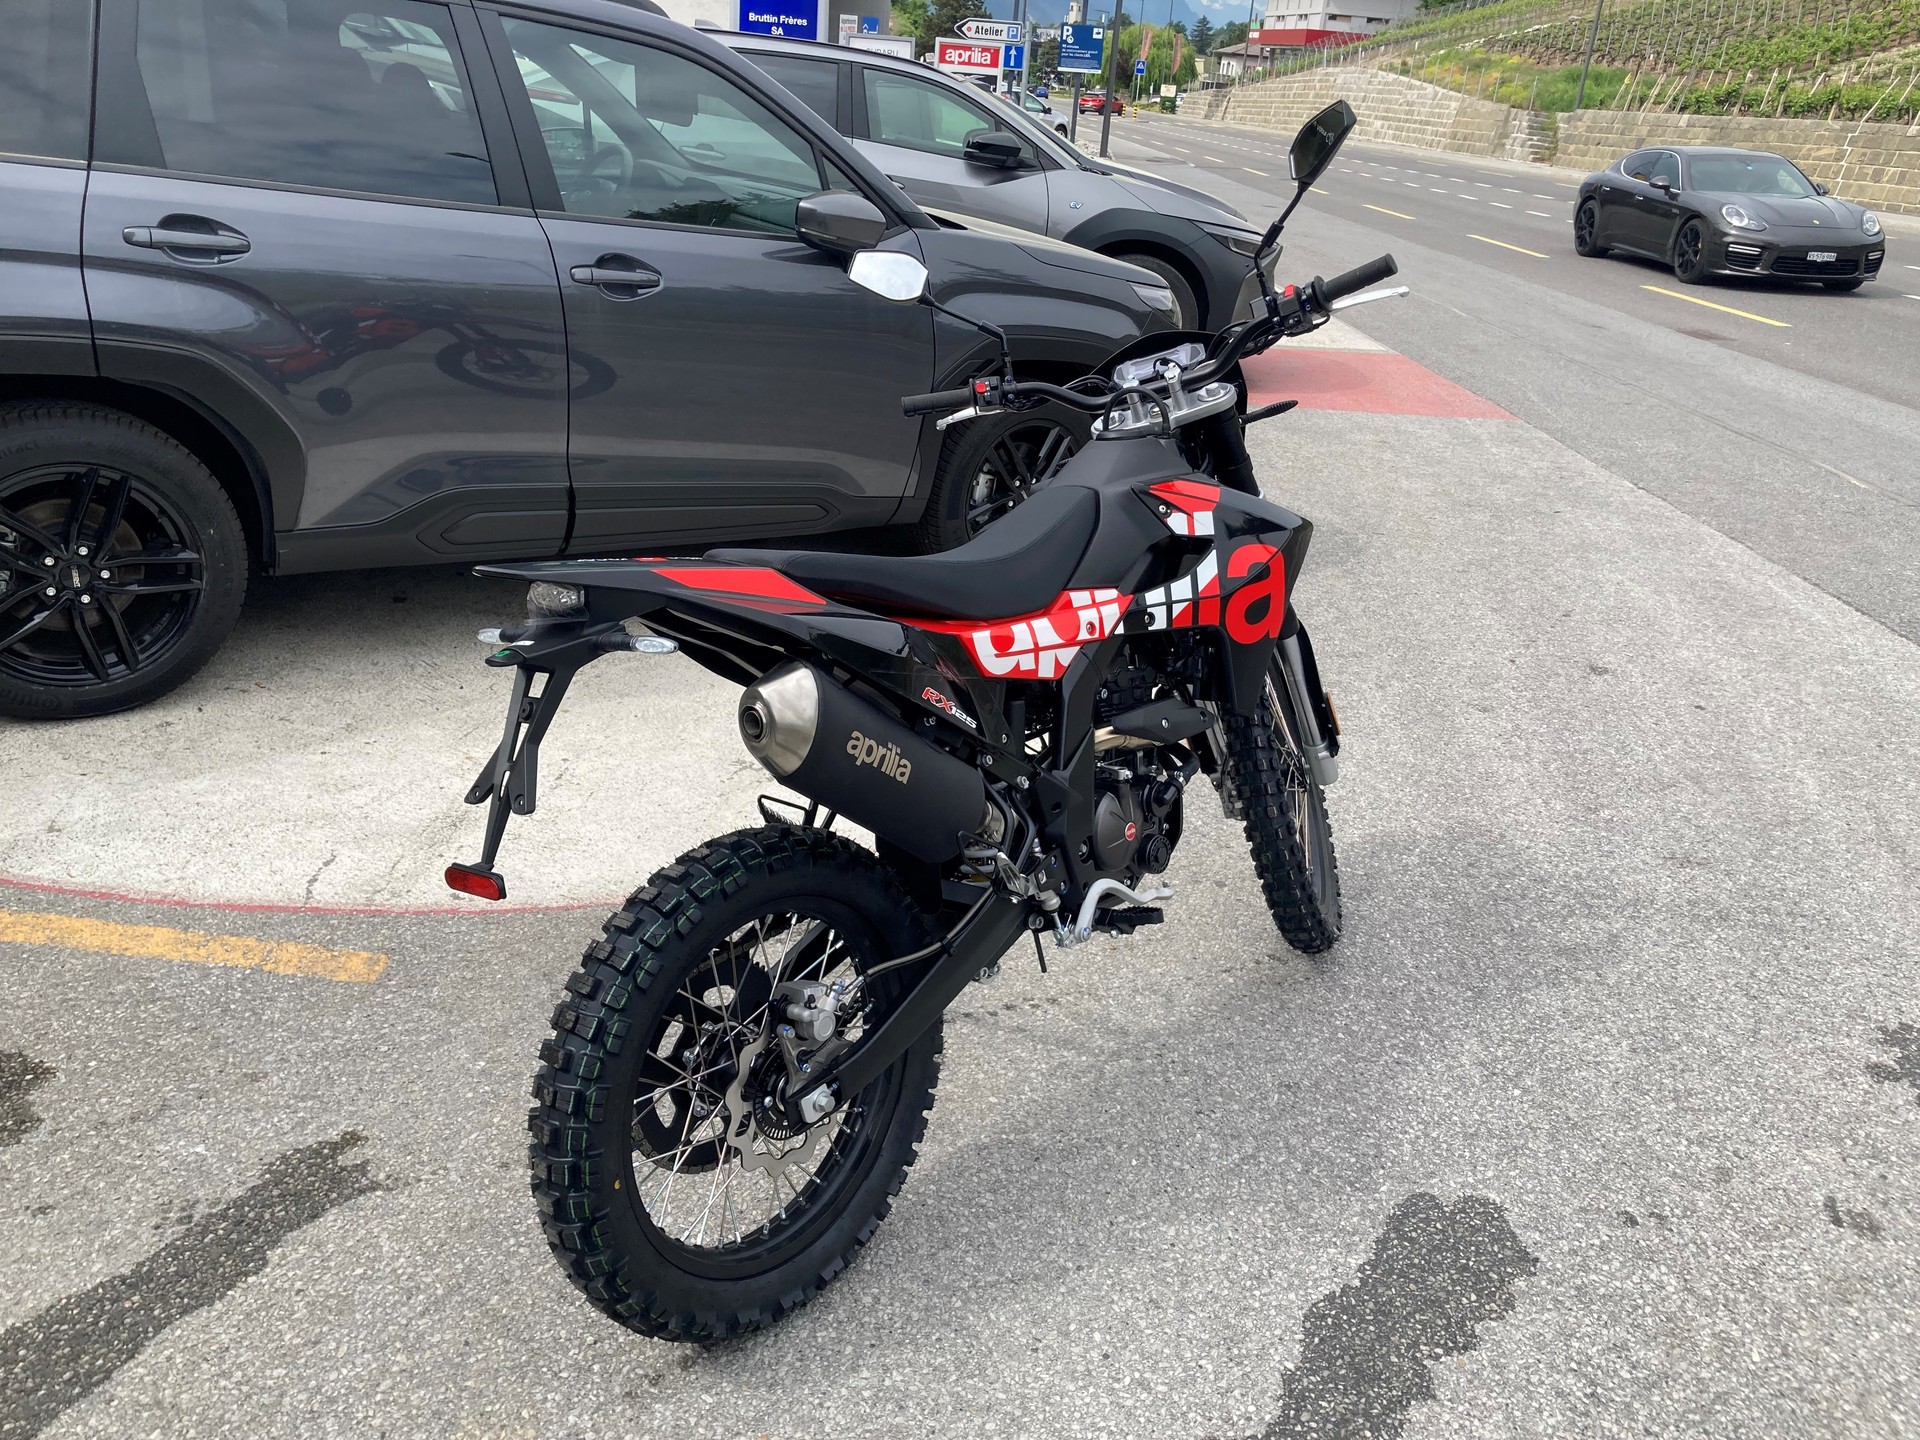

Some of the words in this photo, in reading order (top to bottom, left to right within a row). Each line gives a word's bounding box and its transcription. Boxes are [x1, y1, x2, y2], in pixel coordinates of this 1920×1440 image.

[748, 12, 778, 24] Bruttin
[780, 15, 808, 26] Frères
[771, 26, 784, 36] SA
[974, 25, 1004, 37] Atelier
[1008, 27, 1017, 39] P
[1062, 25, 1073, 40] P
[944, 47, 991, 65] aprilia
[846, 730, 912, 785] aprilia
